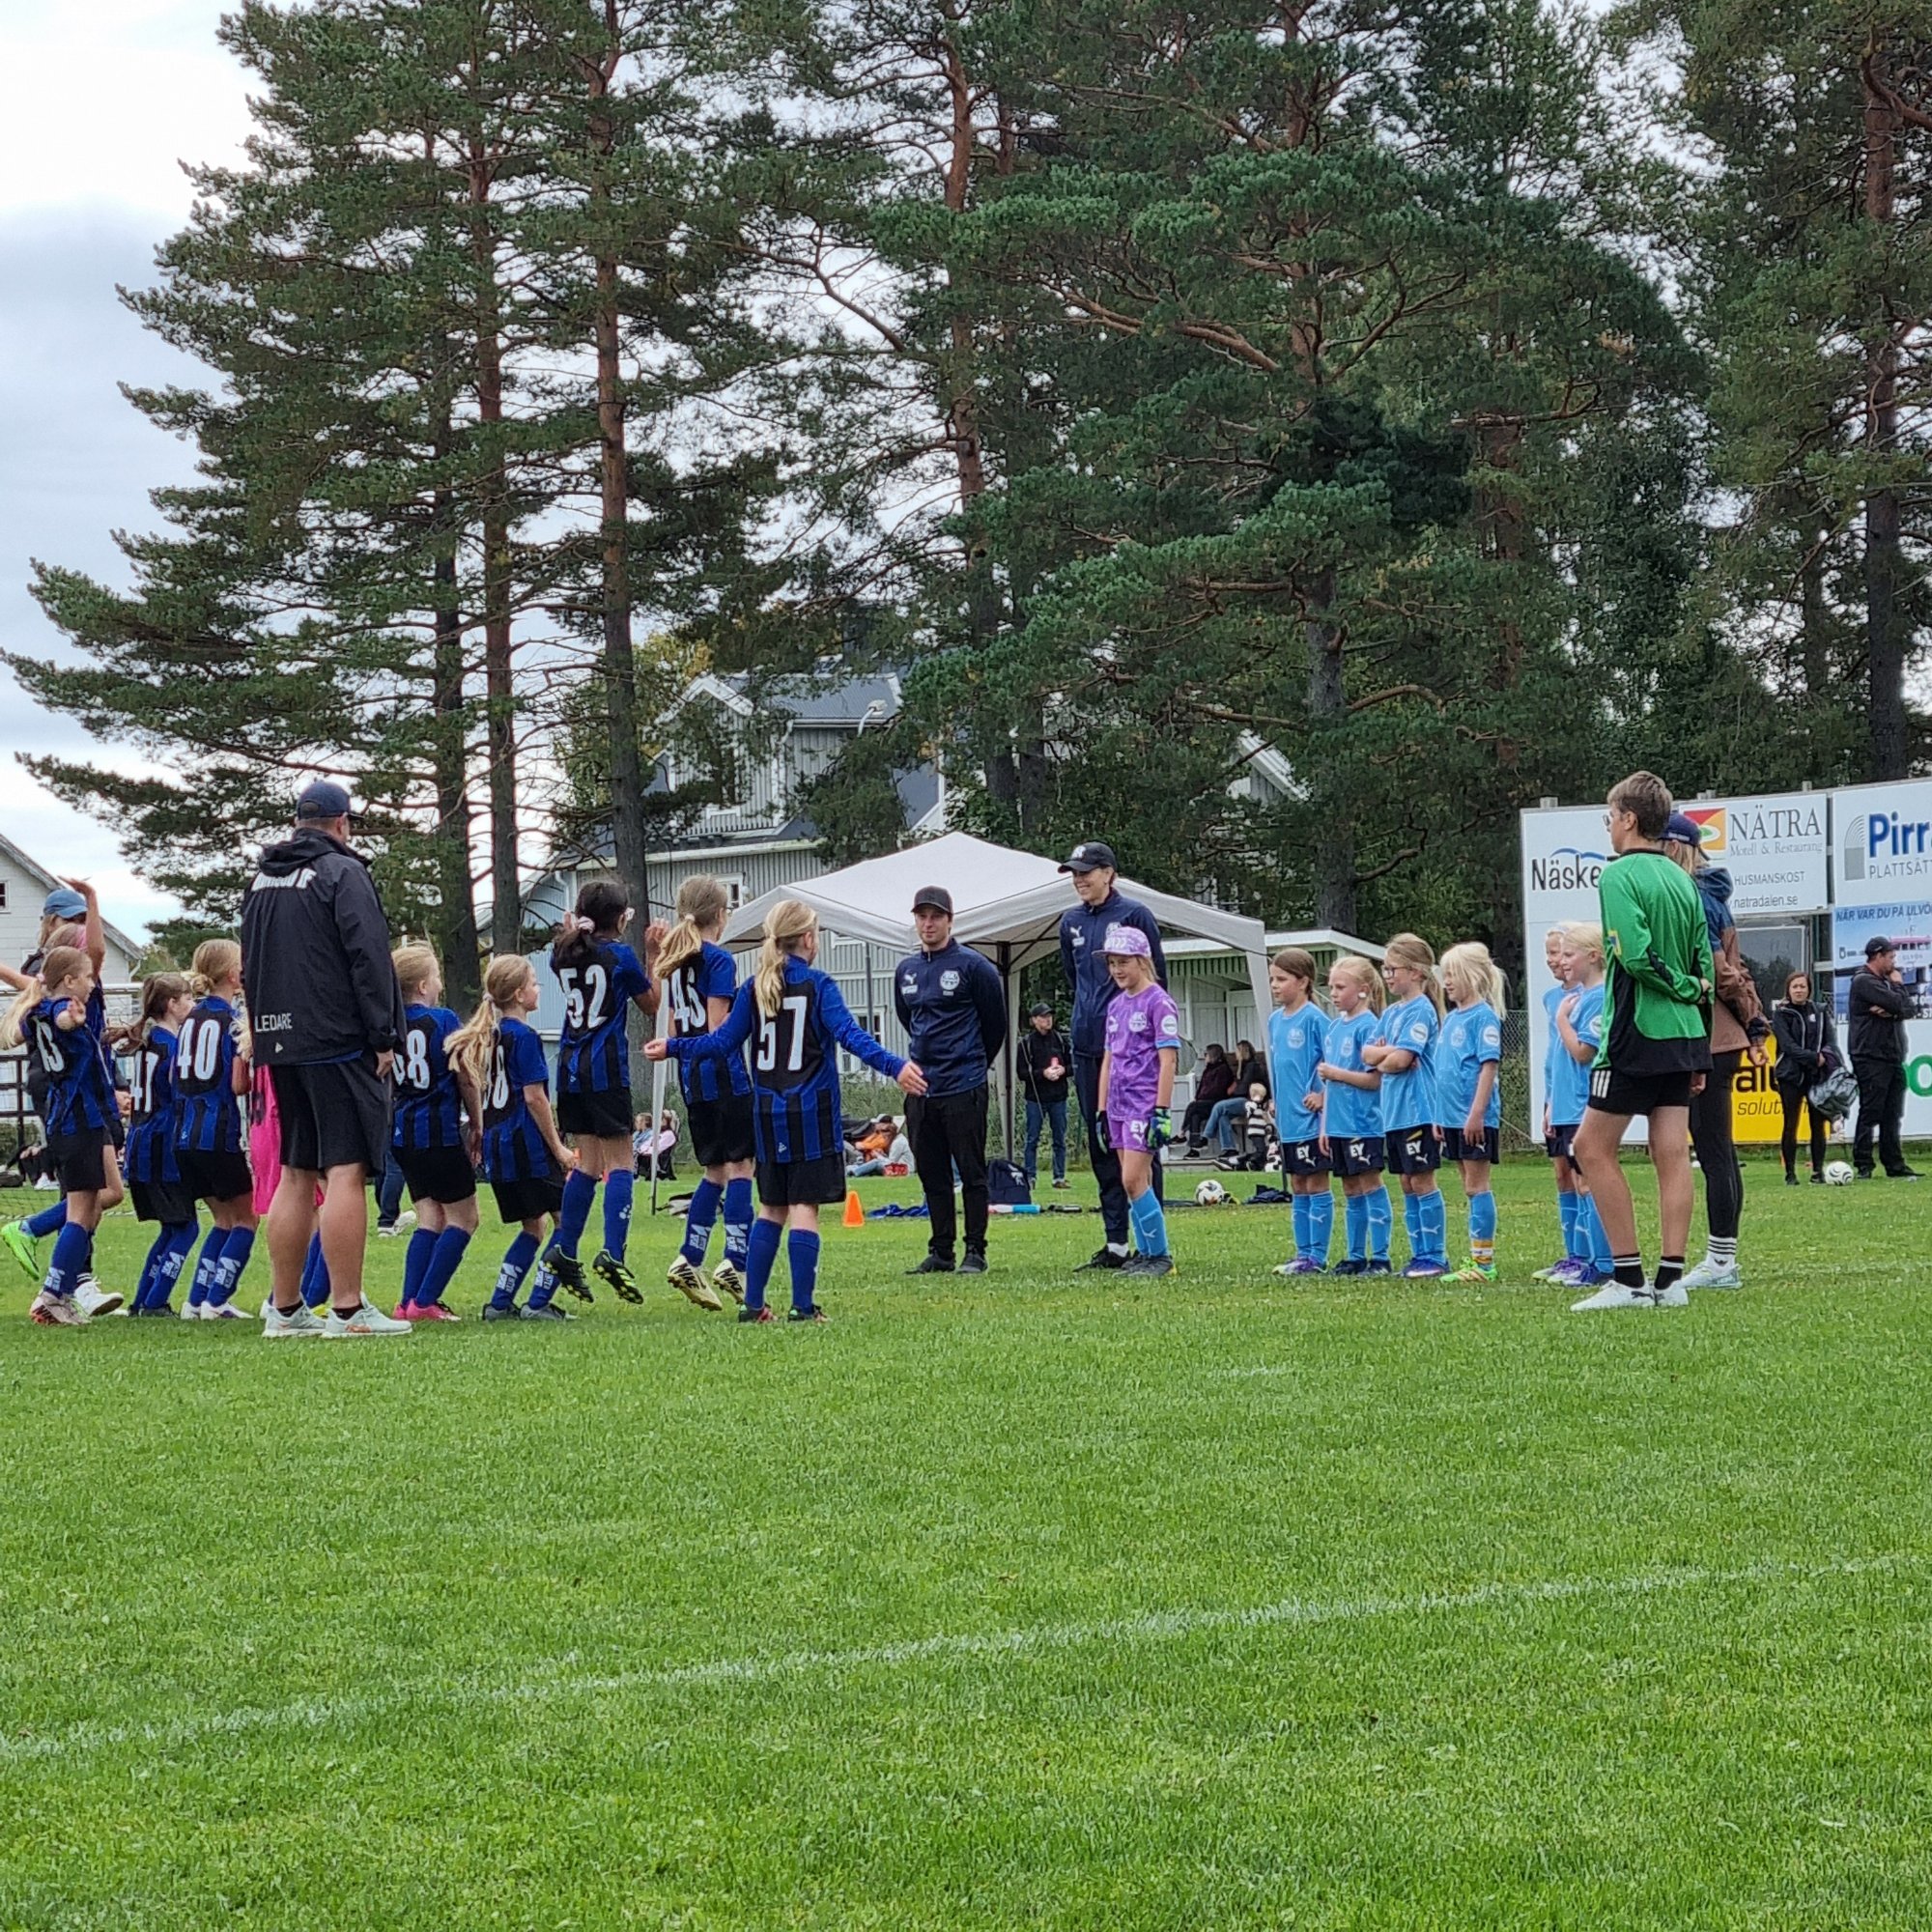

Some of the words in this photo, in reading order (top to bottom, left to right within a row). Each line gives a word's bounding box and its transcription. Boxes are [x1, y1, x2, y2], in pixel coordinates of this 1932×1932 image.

[1730, 805, 1822, 840] NÄTRA
[1869, 811, 1932, 858] Pirr
[1730, 844, 1757, 857] Motell
[1775, 840, 1823, 855] Restaurang
[1734, 871, 1805, 886] HUSMANSKOST
[1869, 858, 1932, 879] PLATTSÄT
[1836, 910, 1856, 922] NÄR
[1857, 908, 1875, 921] VAR
[1877, 907, 1893, 919] DU
[559, 964, 609, 1029] 52
[254, 1012, 293, 1033] LEDARE
[756, 995, 807, 1071] 57
[177, 1018, 221, 1081] 40
[1131, 1121, 1149, 1134] EY
[1296, 1145, 1309, 1159] EY
[1350, 1143, 1364, 1157] EY
[1406, 1141, 1421, 1155] EY
[669, 1263, 700, 1290] NIKE
[716, 1267, 744, 1293] NIKE
